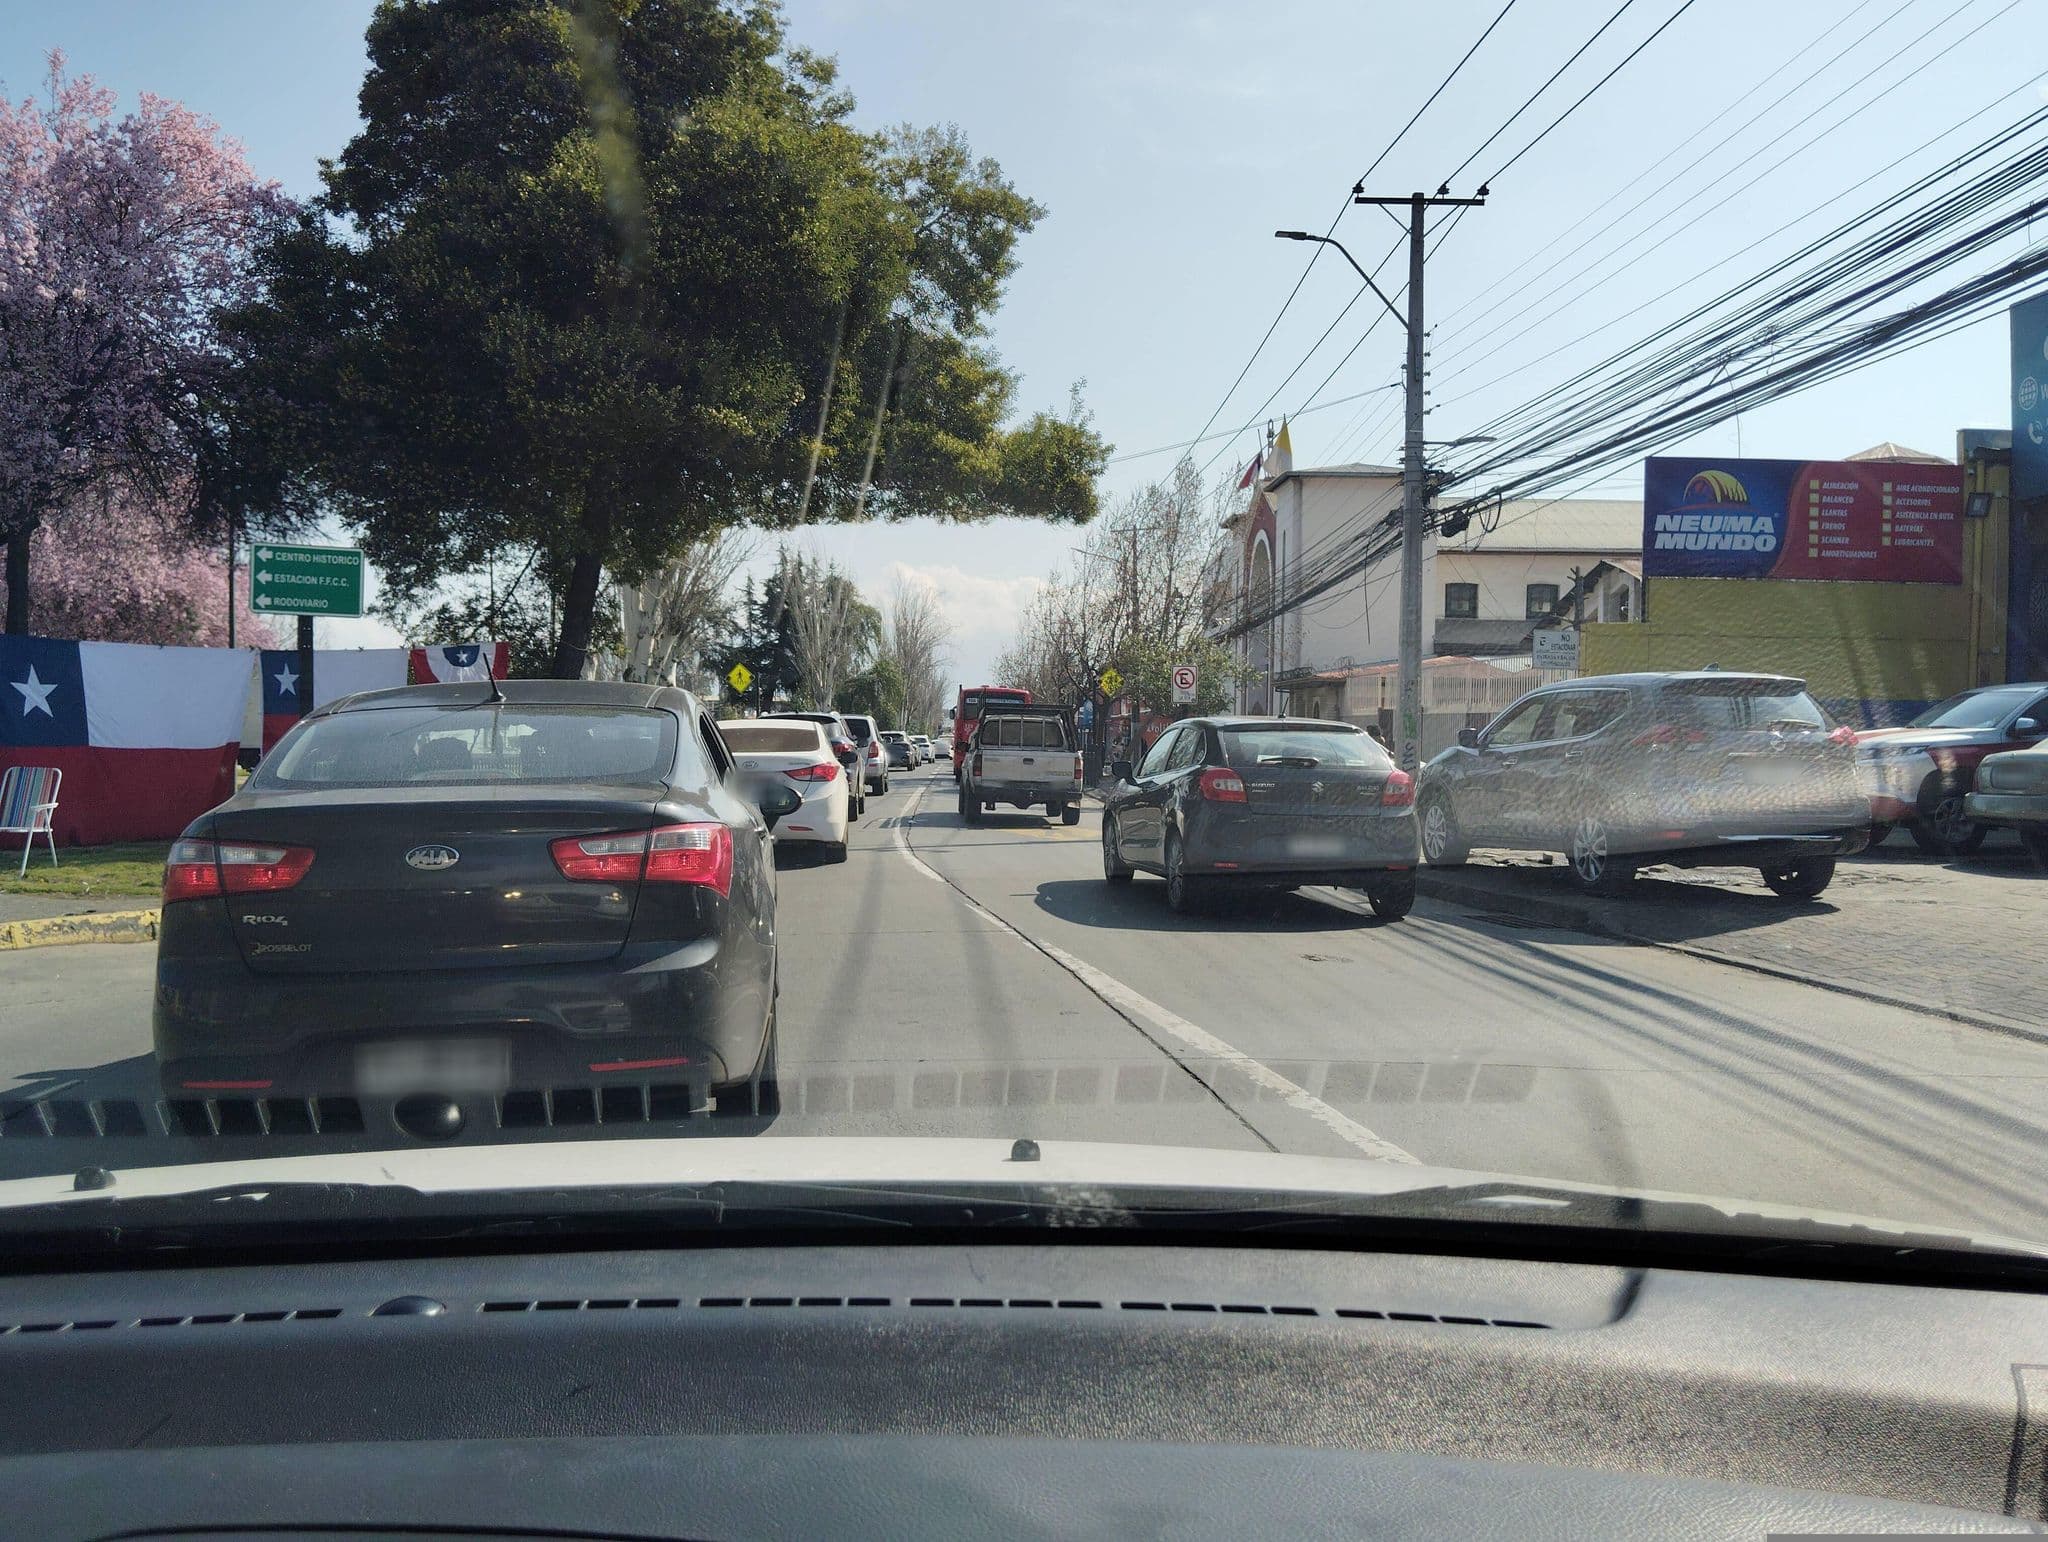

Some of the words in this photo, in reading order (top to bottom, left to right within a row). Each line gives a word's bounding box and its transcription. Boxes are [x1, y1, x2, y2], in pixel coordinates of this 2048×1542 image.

[1822, 495, 1855, 504] BALANCEO
[1895, 498, 1932, 506] ACCESORIOS
[1655, 514, 1775, 534] NEUMA
[1655, 533, 1777, 552] MUNDO
[275, 551, 312, 563] CENTRO
[312, 554, 360, 566] HISTORICO
[274, 573, 318, 585] ESTACION
[273, 597, 329, 609] RODOVIARIO
[410, 848, 453, 867] KIA
